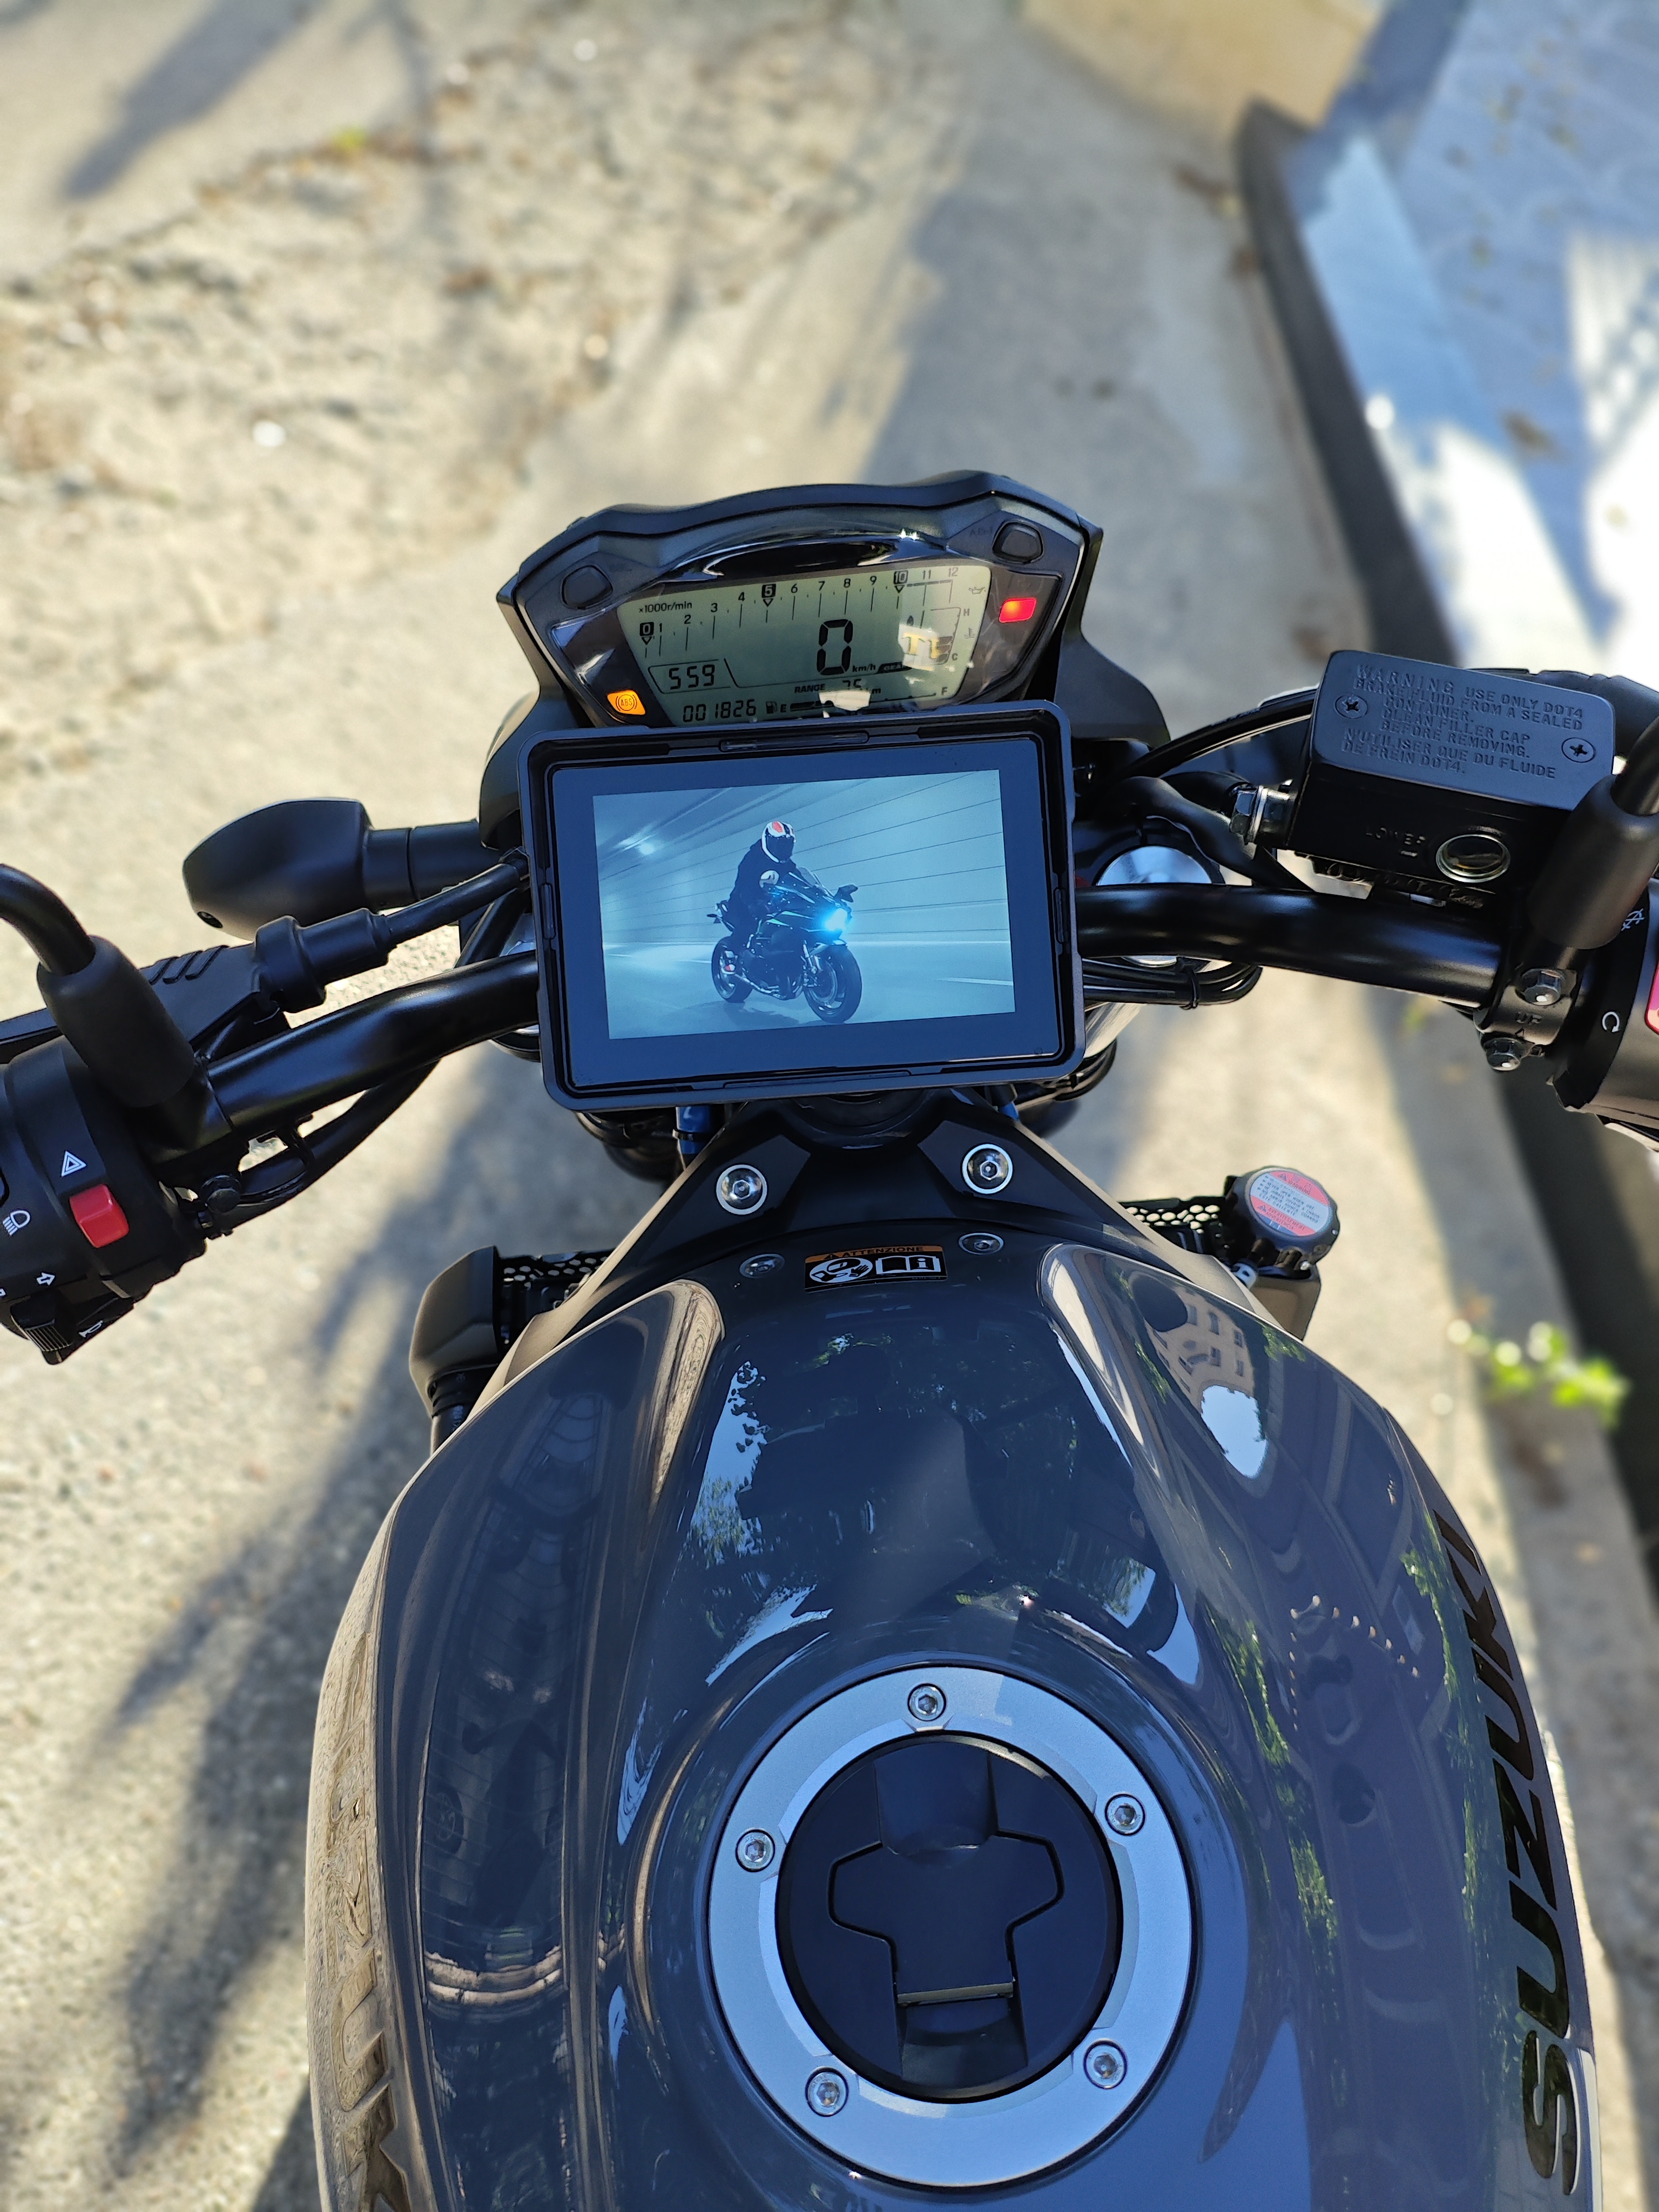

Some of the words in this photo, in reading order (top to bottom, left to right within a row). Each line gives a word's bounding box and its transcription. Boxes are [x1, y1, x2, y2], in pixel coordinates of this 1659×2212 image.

[659, 623, 663, 632] 1
[684, 615, 691, 624] 2
[710, 603, 718, 613] 3
[738, 592, 745, 602] 4
[764, 585, 774, 597] 5
[791, 583, 798, 594] 6
[818, 581, 825, 591] 7
[844, 578, 851, 588] 8
[869, 576, 877, 585] 9
[895, 571, 907, 583] 10
[922, 570, 931, 579] 11
[948, 567, 959, 577] 12
[816, 619, 853, 675] 0
[852, 664, 876, 672] km/h
[621, 698, 632, 706] ABS
[794, 684, 825, 693] RANGE
[941, 687, 948, 695] F
[1353, 677, 1407, 699] BRAKE
[1408, 688, 1455, 707] FLUID
[1460, 697, 1502, 716] FROM
[1506, 706, 1517, 718] A
[1520, 709, 1584, 732] SEALED
[1355, 664, 1455, 696] WARNING
[1464, 686, 1496, 703] USE
[1500, 693, 1539, 711] ONLY
[1542, 702, 1584, 720] DOT4
[683, 699, 756, 722] 001826
[780, 704, 786, 713] E
[1383, 696, 1475, 724] CONTAINER.
[1378, 719, 1442, 742] BEFORE
[1447, 732, 1531, 759] REMOVING.
[1381, 707, 1433, 728] CLEAN
[1439, 718, 1495, 739] FILLER
[1500, 730, 1530, 746] CAP
[1340, 738, 1364, 755] DE
[1366, 744, 1414, 765] FREIN
[1435, 746, 1469, 763] QUE
[1473, 752, 1495, 767] DU
[1498, 757, 1557, 779] FLUIDE
[842, 1246, 924, 1257] ATTENZIONE
[1432, 1509, 1577, 2195] SUZUKI
[327, 1632, 412, 2212] SUZUK
